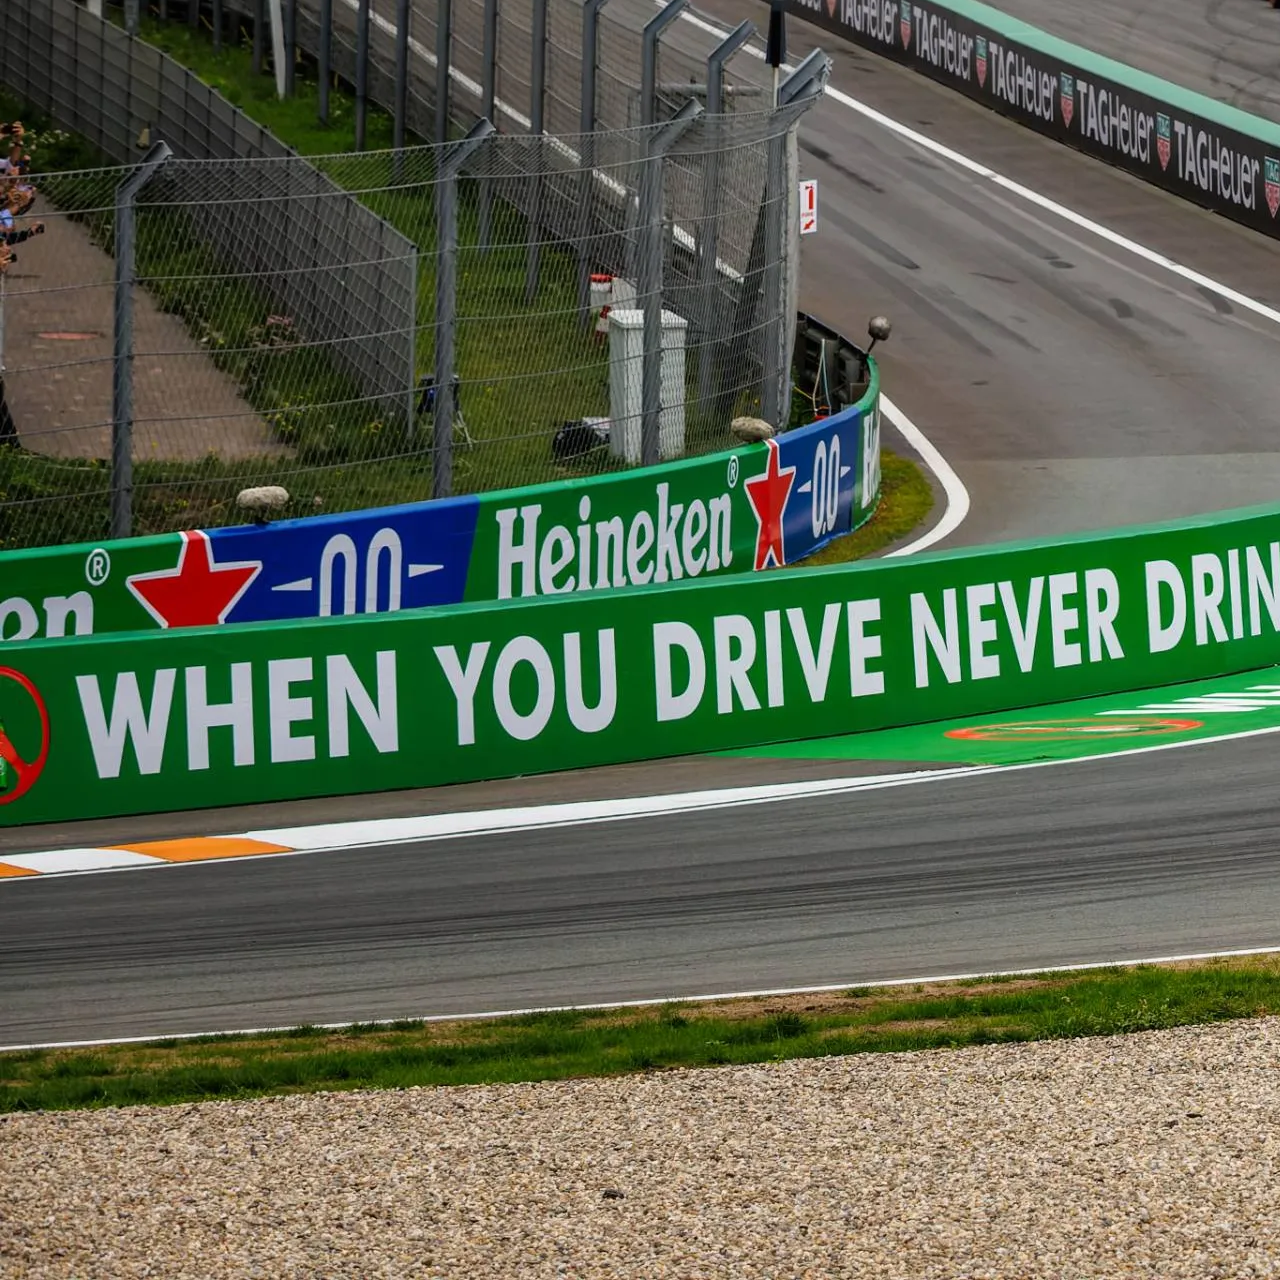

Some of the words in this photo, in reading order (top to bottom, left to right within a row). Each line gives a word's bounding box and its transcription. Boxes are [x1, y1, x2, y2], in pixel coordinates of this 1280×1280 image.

[495, 482, 735, 601] Heineken
[812, 434, 841, 539] 0.0
[76, 649, 401, 779] WHEN
[432, 627, 618, 748] YOU
[653, 597, 886, 723] DRIVE
[910, 568, 1125, 688] NEVER
